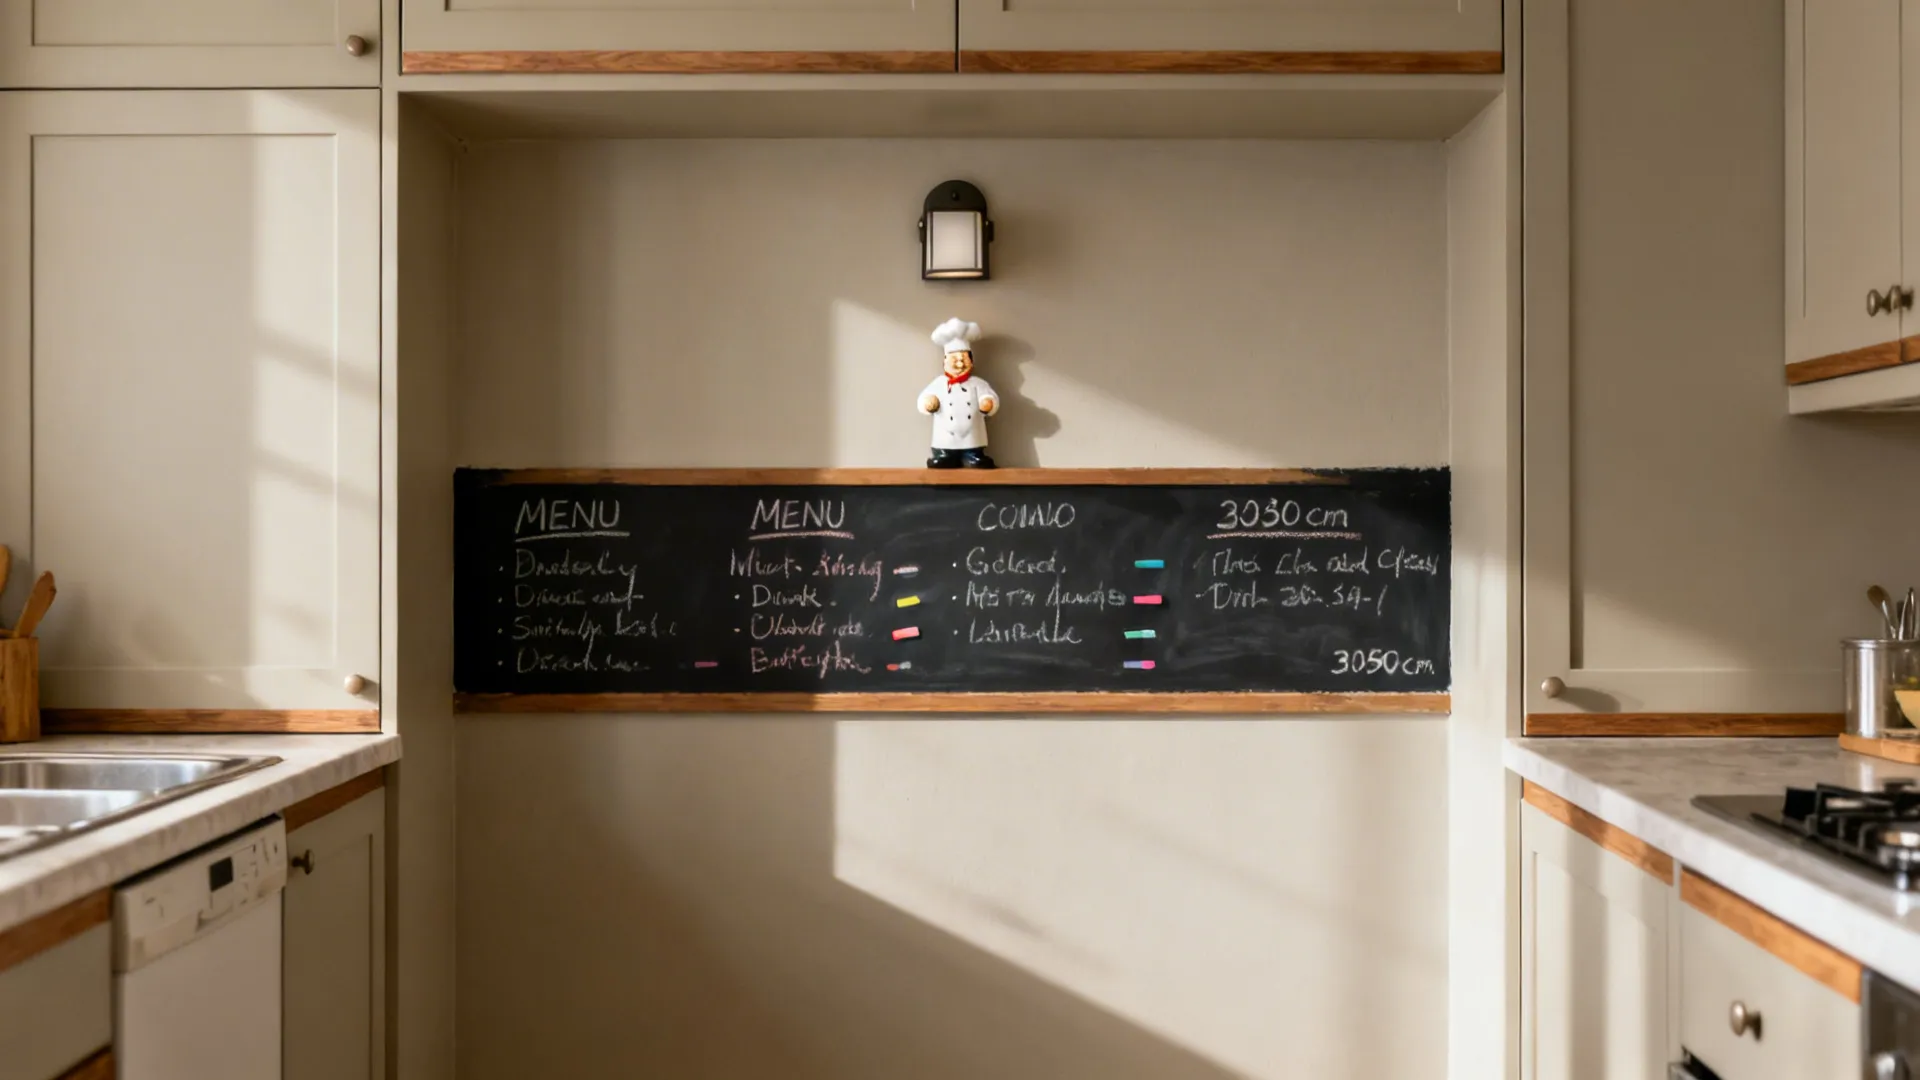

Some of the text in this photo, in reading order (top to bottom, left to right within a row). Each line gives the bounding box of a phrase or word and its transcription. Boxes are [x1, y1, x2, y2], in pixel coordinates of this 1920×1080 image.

[515, 498, 620, 534] MENU
[750, 499, 845, 530] MENU
[1306, 507, 1348, 527] cm
